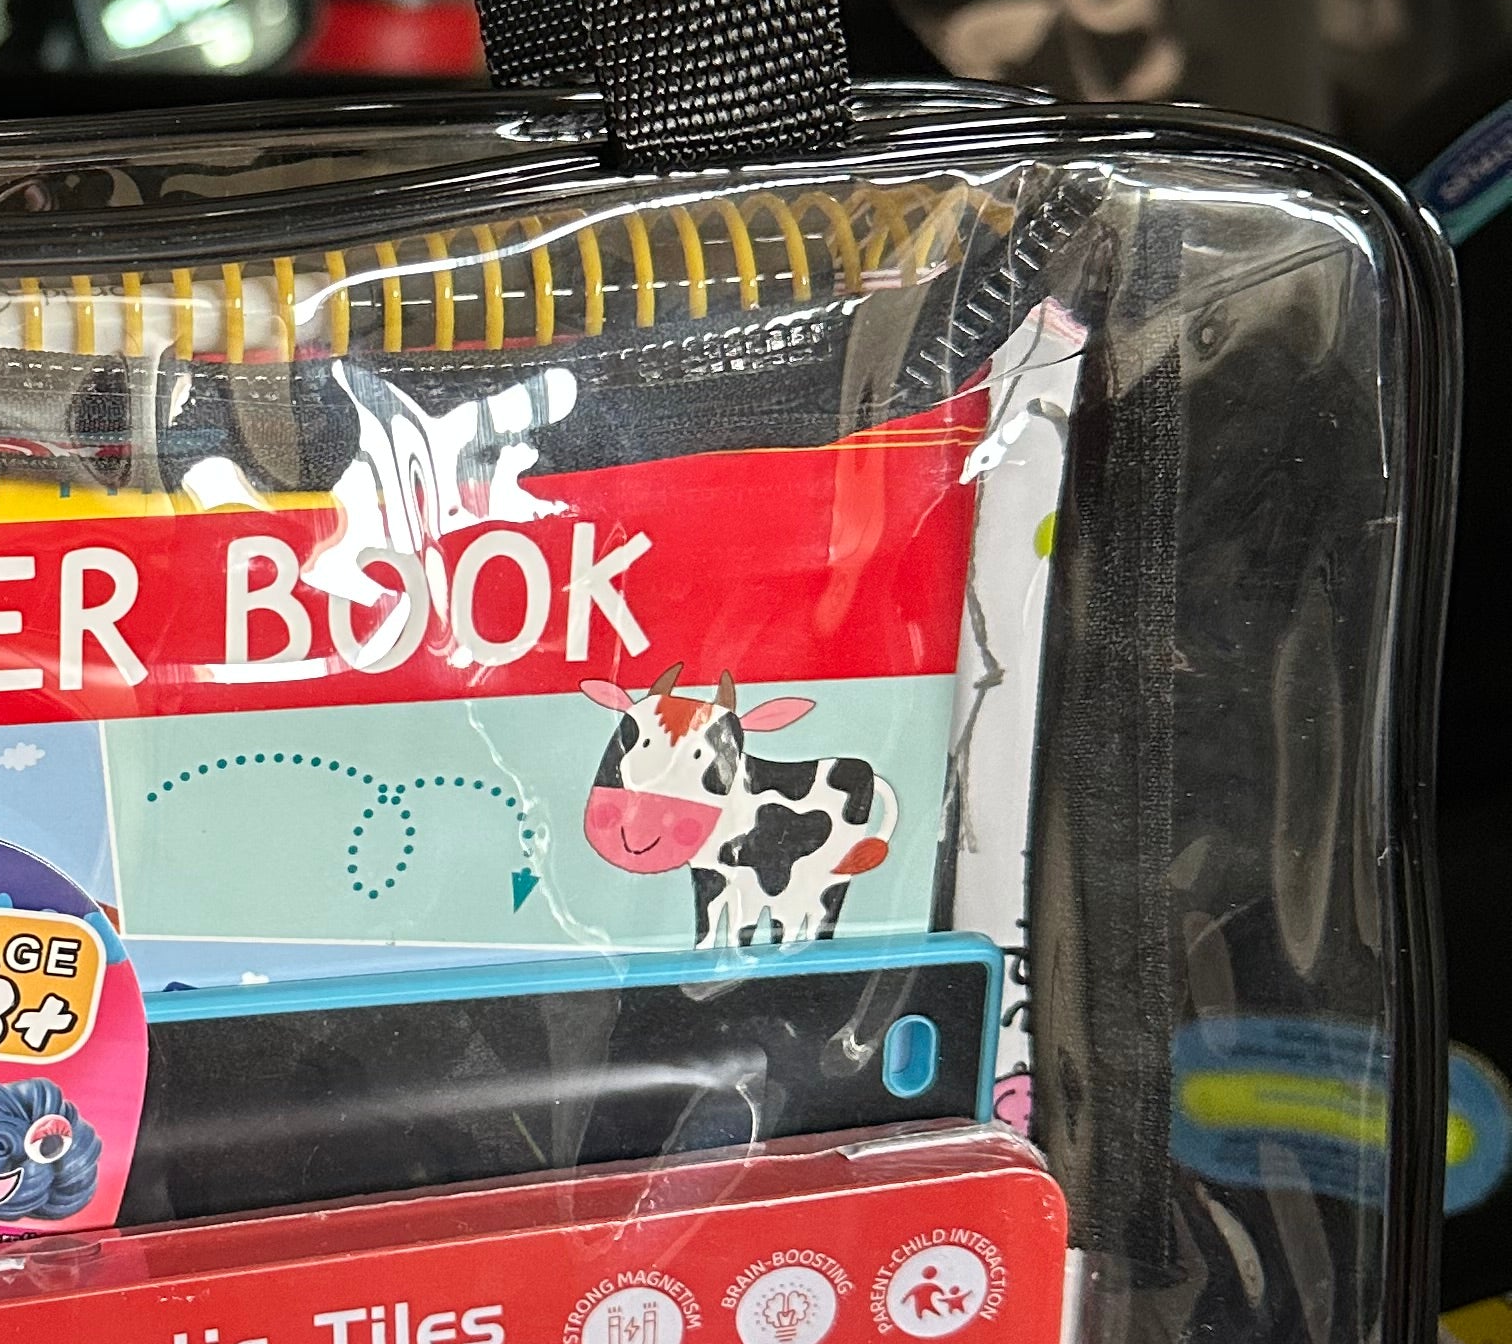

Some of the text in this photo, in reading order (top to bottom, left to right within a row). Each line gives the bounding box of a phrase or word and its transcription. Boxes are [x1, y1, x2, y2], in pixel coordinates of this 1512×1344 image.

[224, 521, 653, 674] BOOK
[617, 1269, 705, 1331] MAGNETISM
[720, 1248, 855, 1310] BRAIN-BOOSTING
[949, 1227, 1008, 1321] INTERACTION
